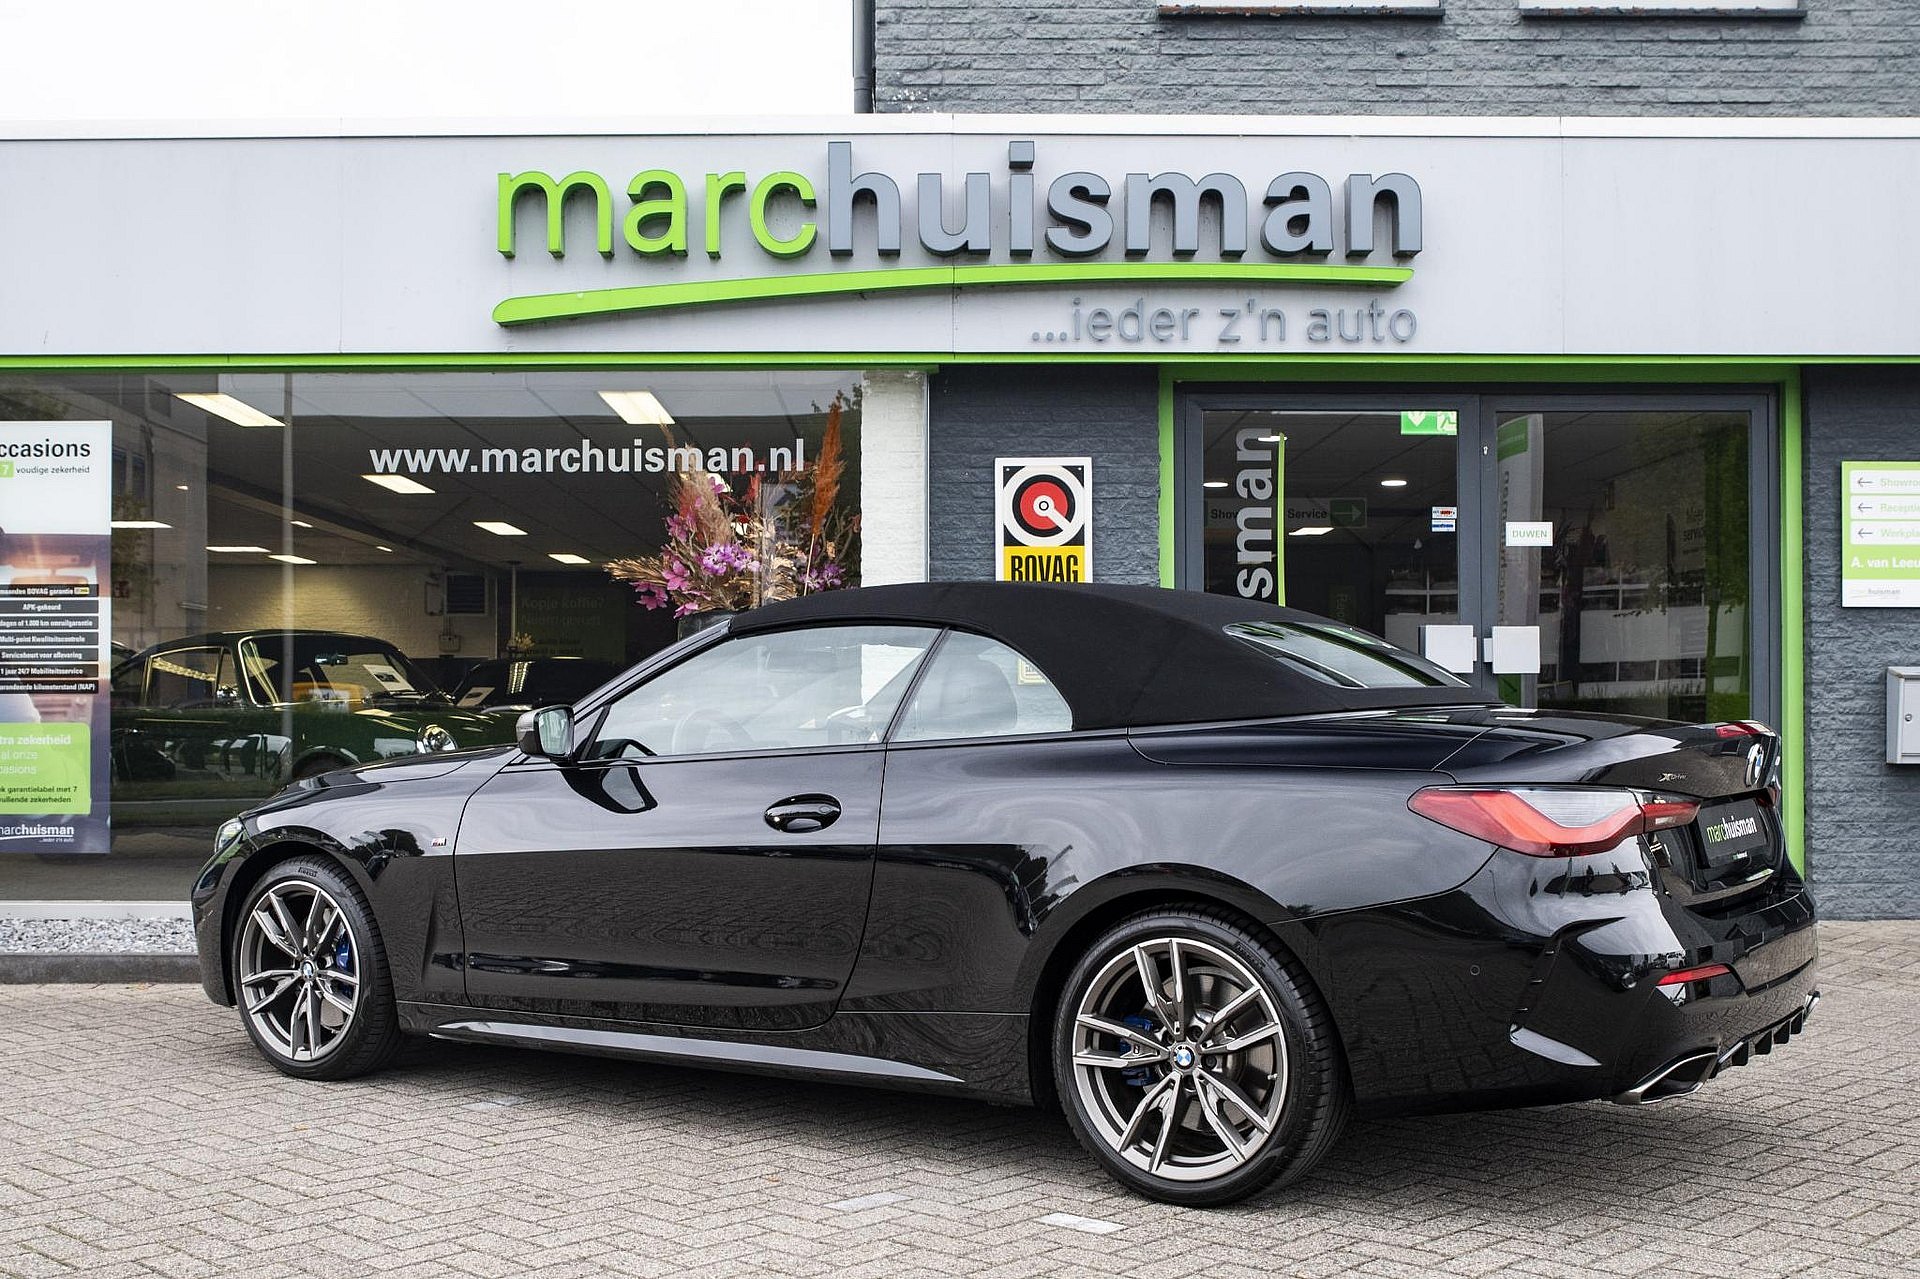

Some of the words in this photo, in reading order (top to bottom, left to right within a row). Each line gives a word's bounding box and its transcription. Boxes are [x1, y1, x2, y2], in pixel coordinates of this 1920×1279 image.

[497, 141, 1423, 259] marchuisman
[1031, 297, 1200, 344] ...ieder
[1218, 298, 1287, 343] z'n
[1307, 299, 1417, 344] auto
[1, 464, 9, 474] 7
[16, 466, 49, 475] voudige
[51, 465, 90, 474] zekerheid
[369, 438, 805, 473] www.marchuisman.nl
[1287, 508, 1328, 519] Service
[1512, 530, 1548, 538] DUWEN
[1010, 554, 1079, 582] BOVAG
[1867, 559, 1889, 568] van
[1706, 815, 1758, 843] marchuisman
